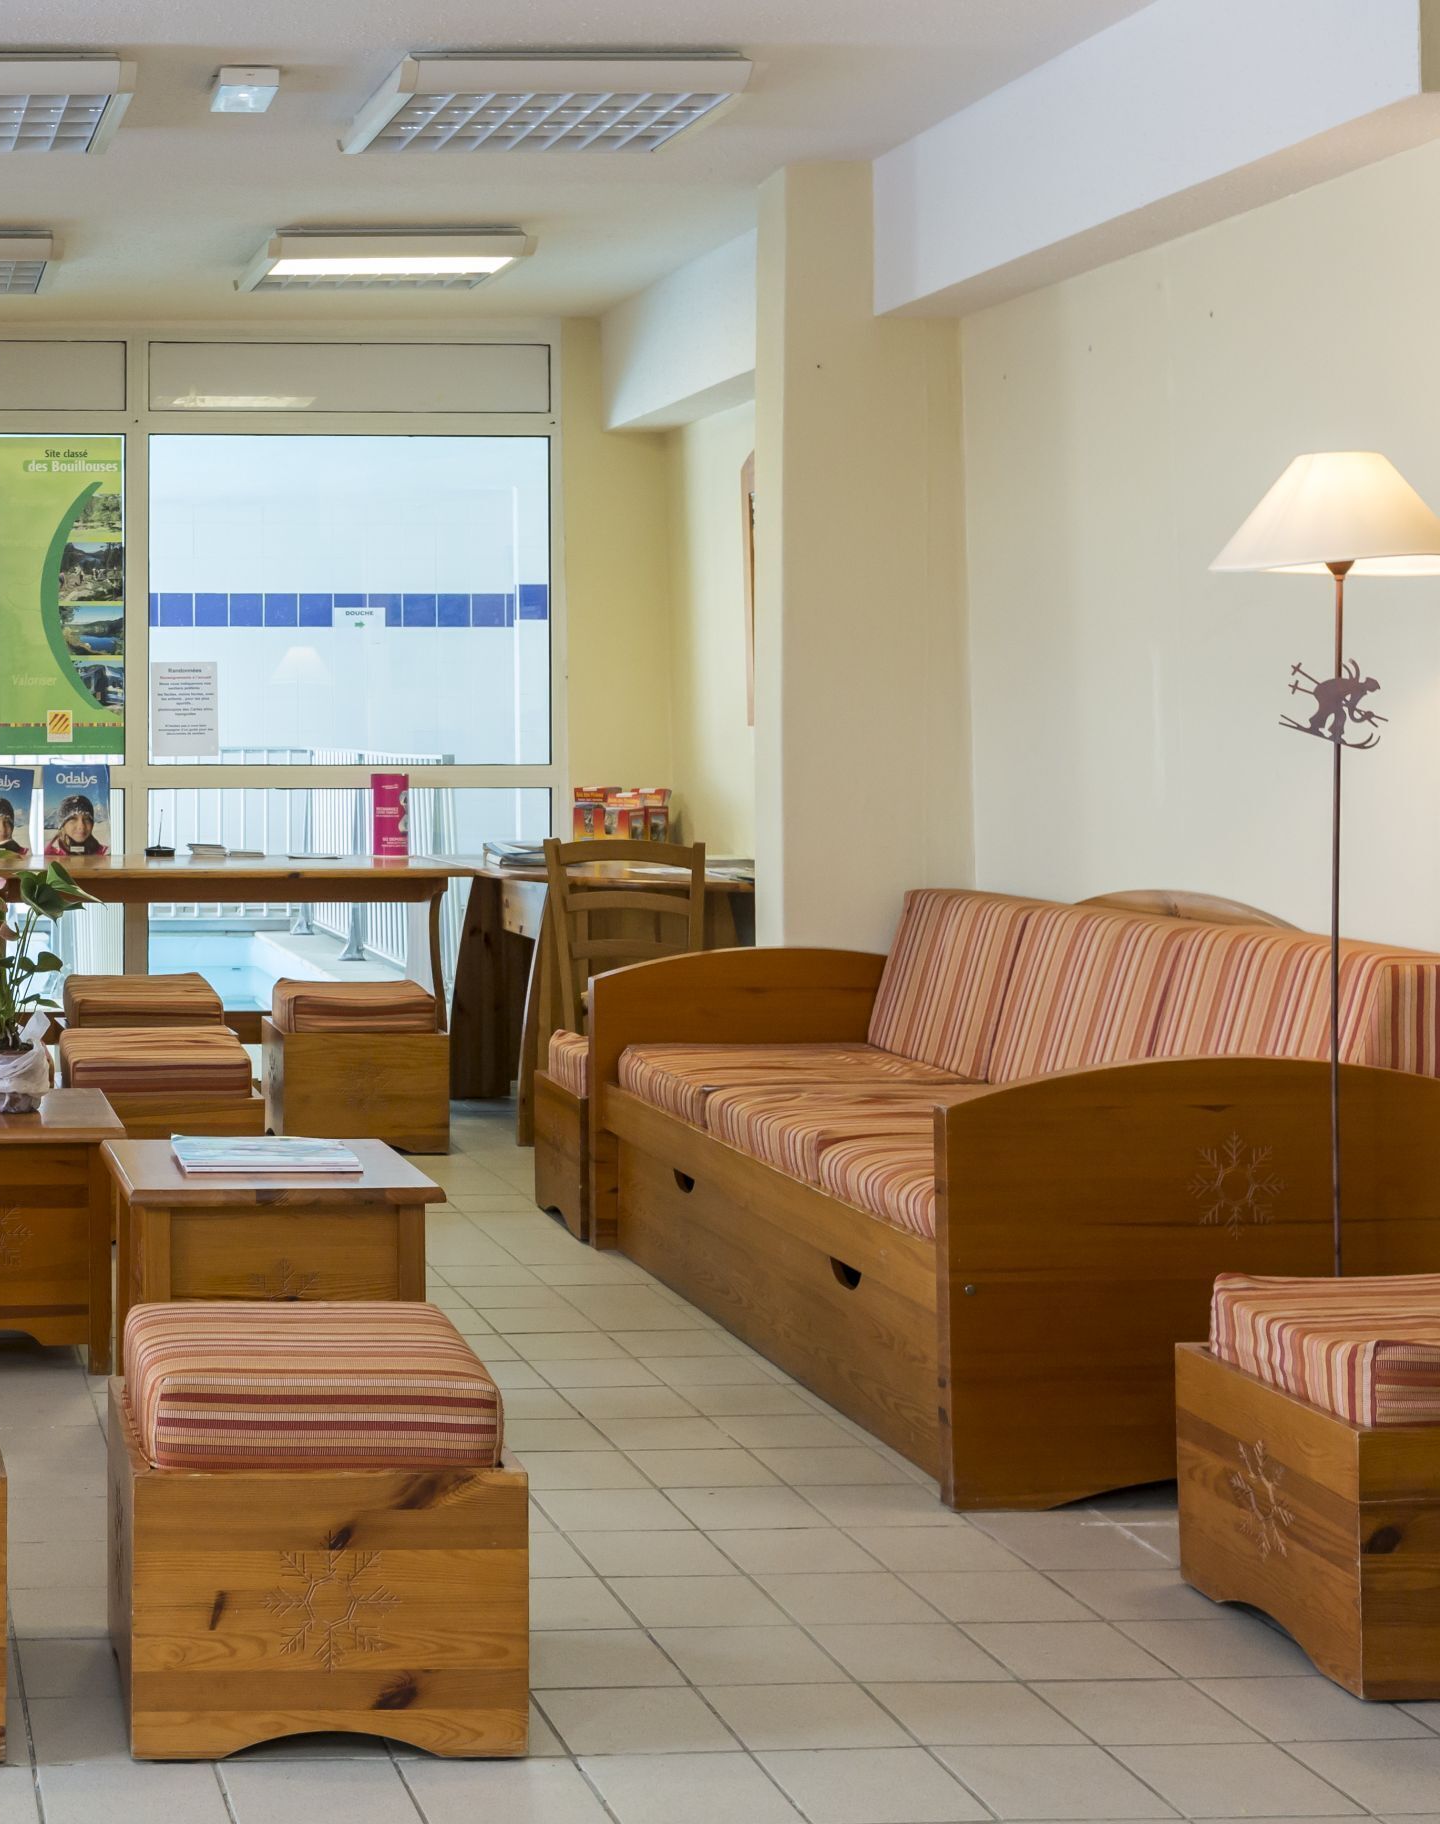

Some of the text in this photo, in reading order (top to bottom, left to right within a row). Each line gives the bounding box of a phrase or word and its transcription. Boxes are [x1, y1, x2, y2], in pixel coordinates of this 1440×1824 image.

[44, 448, 88, 458] Site classé
[28, 459, 118, 472] des Bouillouses
[55, 772, 98, 789] Odalys
